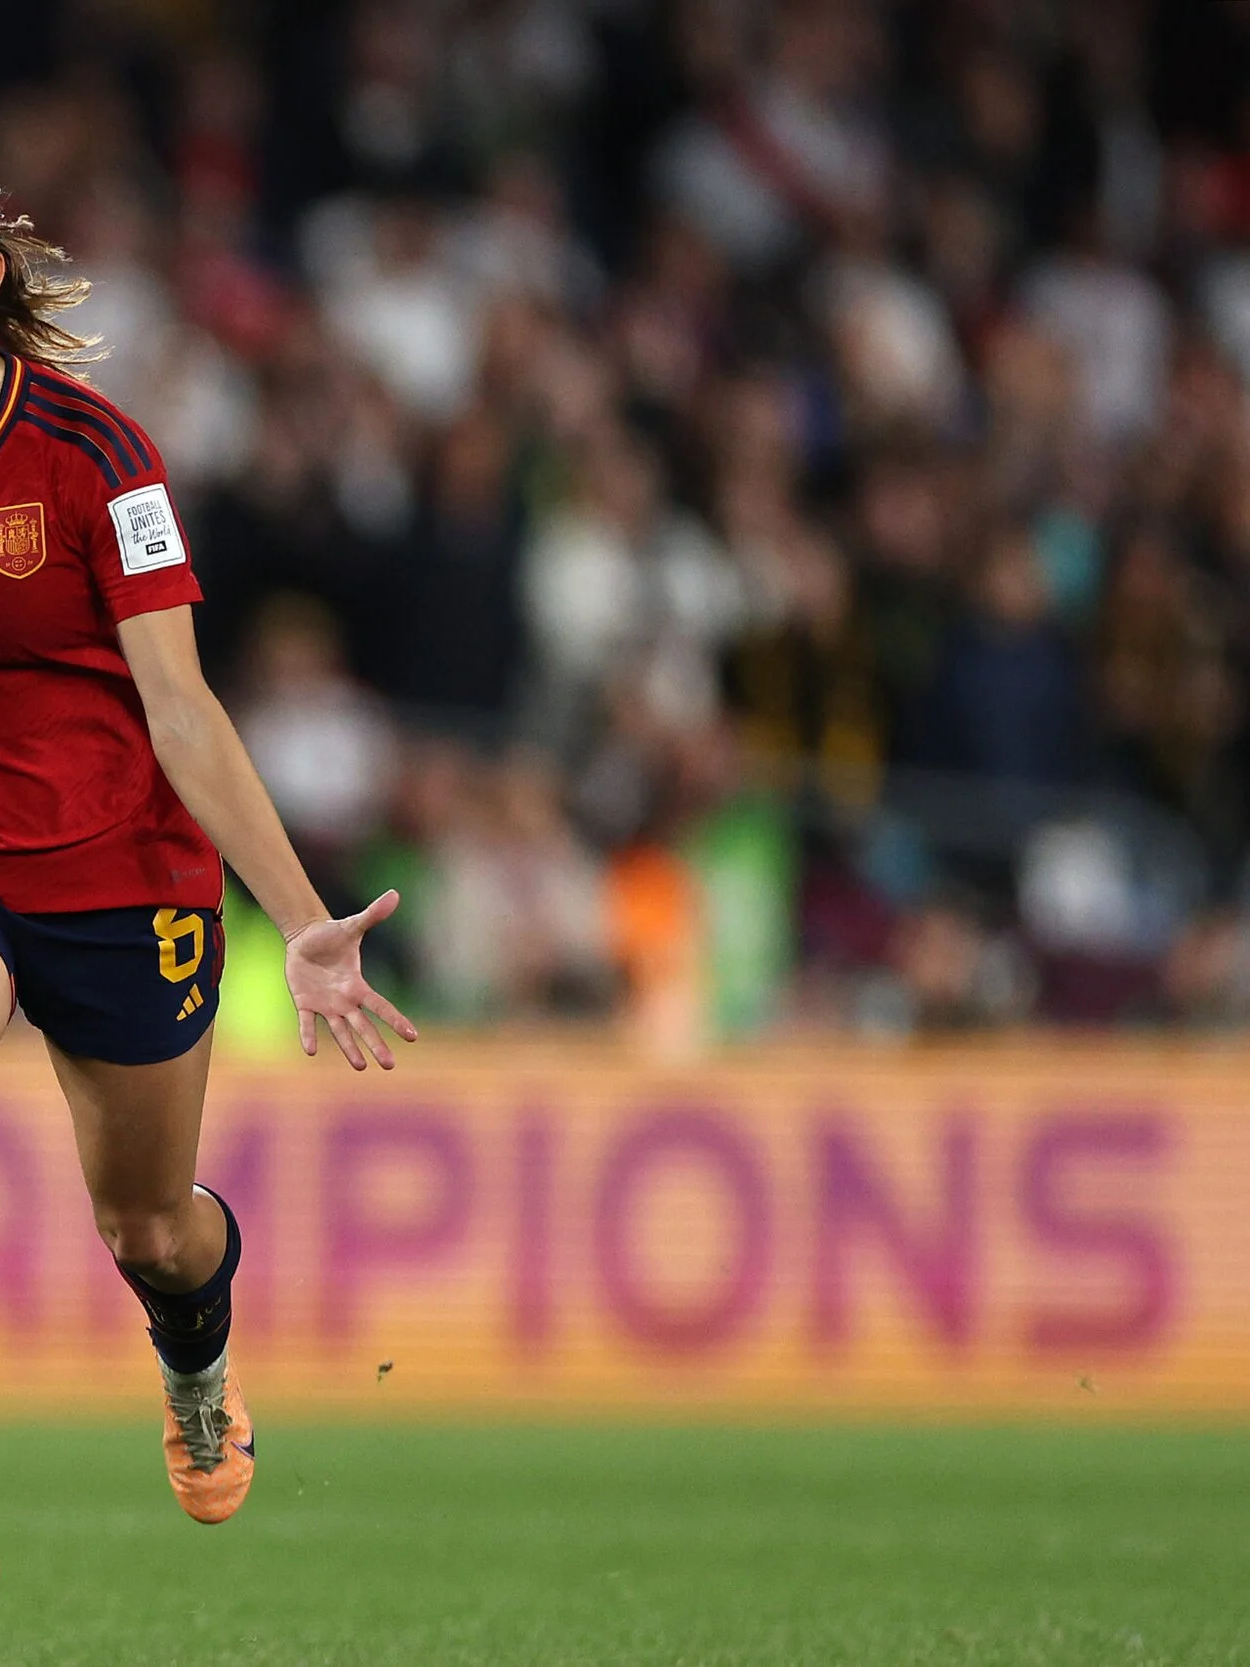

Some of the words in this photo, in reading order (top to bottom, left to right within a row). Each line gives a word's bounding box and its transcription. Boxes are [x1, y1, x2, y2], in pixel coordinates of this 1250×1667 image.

[127, 500, 162, 517] FOOTBALL
[130, 510, 166, 531] UNITES
[131, 531, 148, 544] the
[148, 543, 165, 553] FIFA
[152, 908, 204, 983] 6
